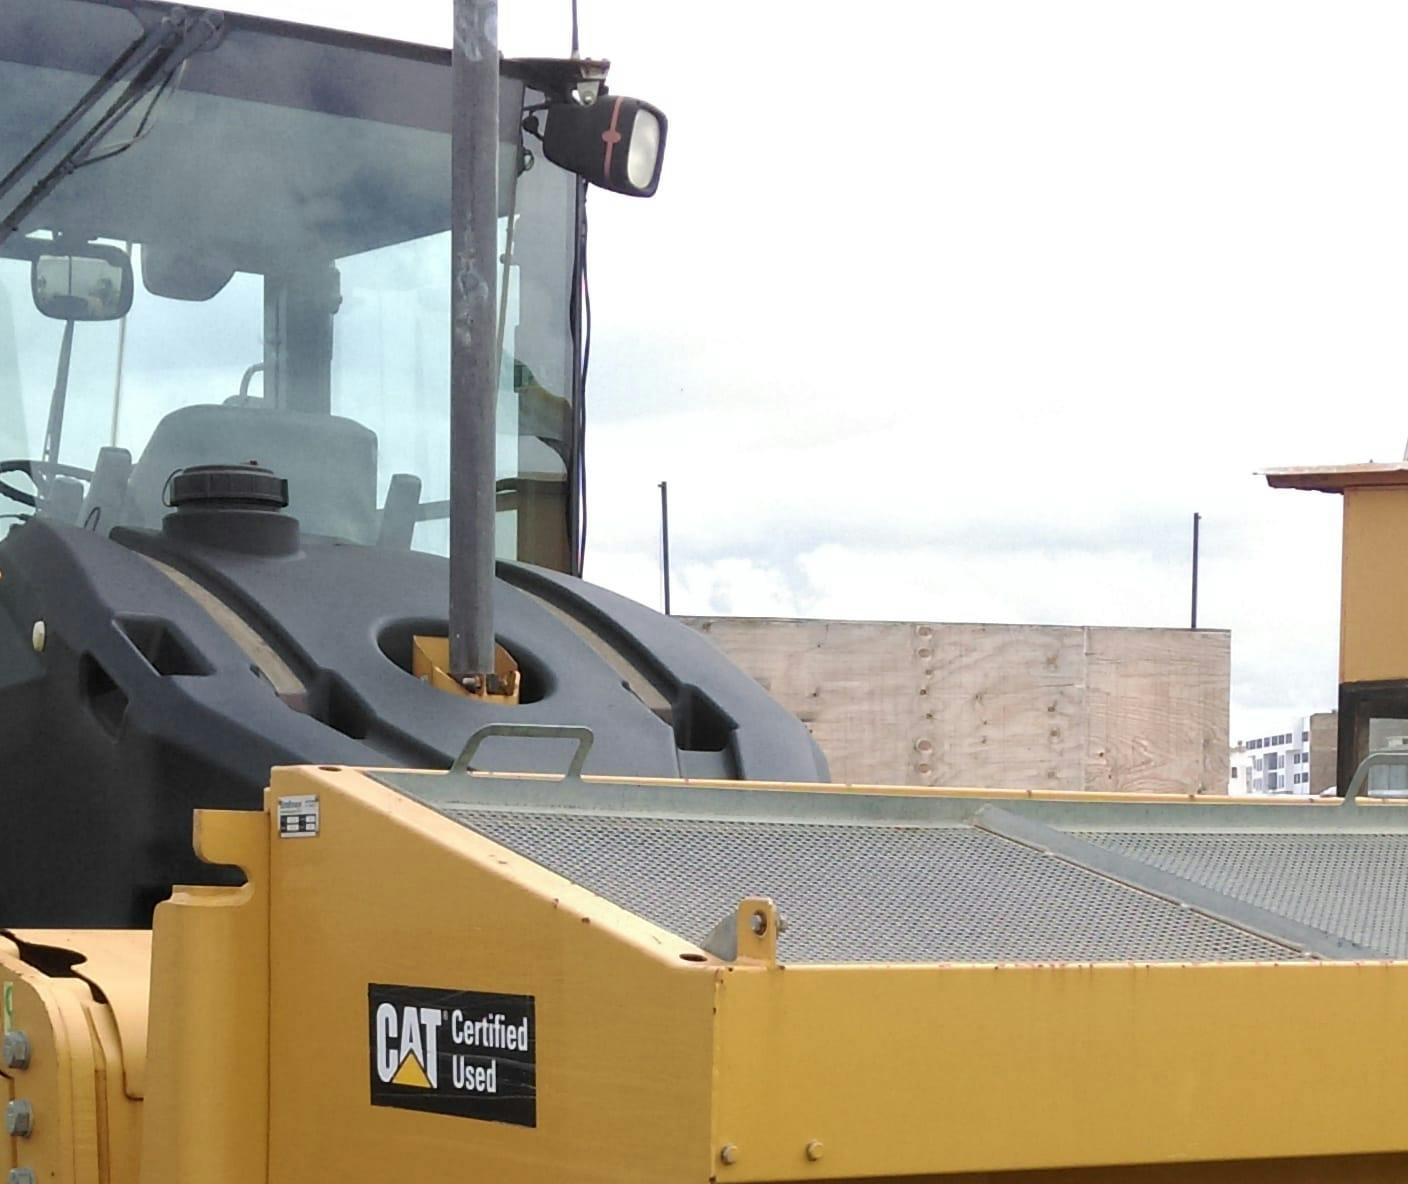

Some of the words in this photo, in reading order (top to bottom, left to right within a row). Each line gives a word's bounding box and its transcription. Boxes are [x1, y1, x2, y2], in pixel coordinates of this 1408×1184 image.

[376, 1002, 442, 1089] CAT
[451, 1009, 528, 1052] Certified
[452, 1054, 497, 1093] Used
